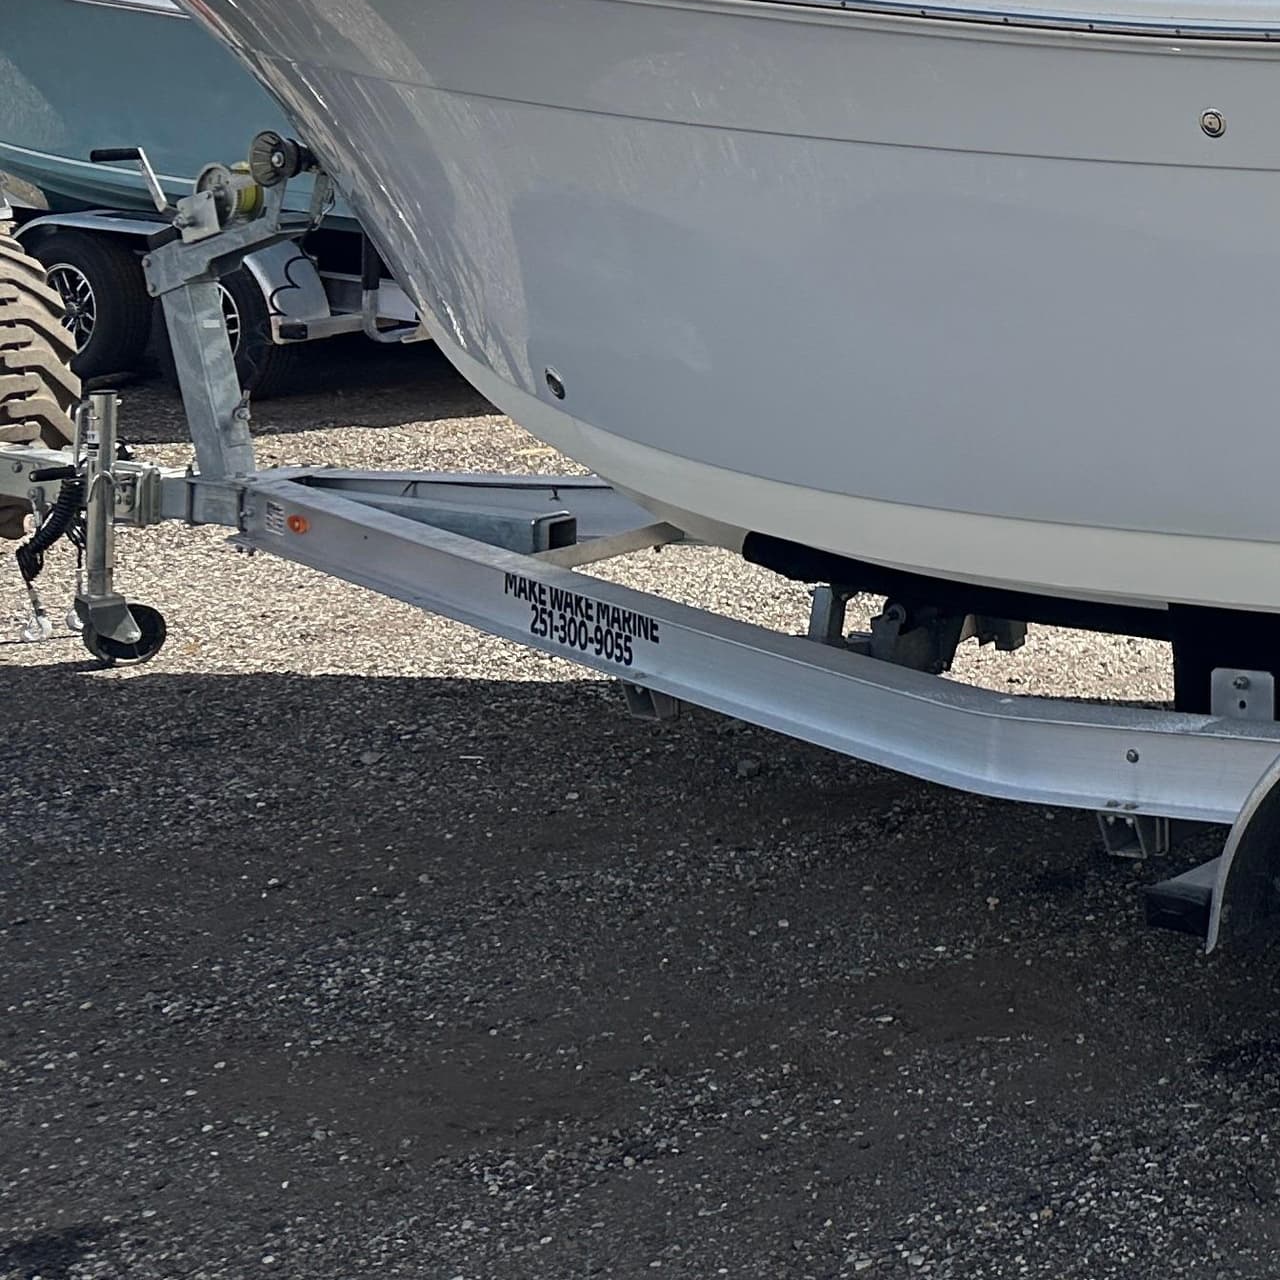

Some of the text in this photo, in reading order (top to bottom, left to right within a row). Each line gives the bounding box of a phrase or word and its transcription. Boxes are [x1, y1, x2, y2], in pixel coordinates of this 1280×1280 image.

[504, 572, 660, 644] MAKE WAKE MARINE
[530, 604, 633, 665] 251-300-9055
